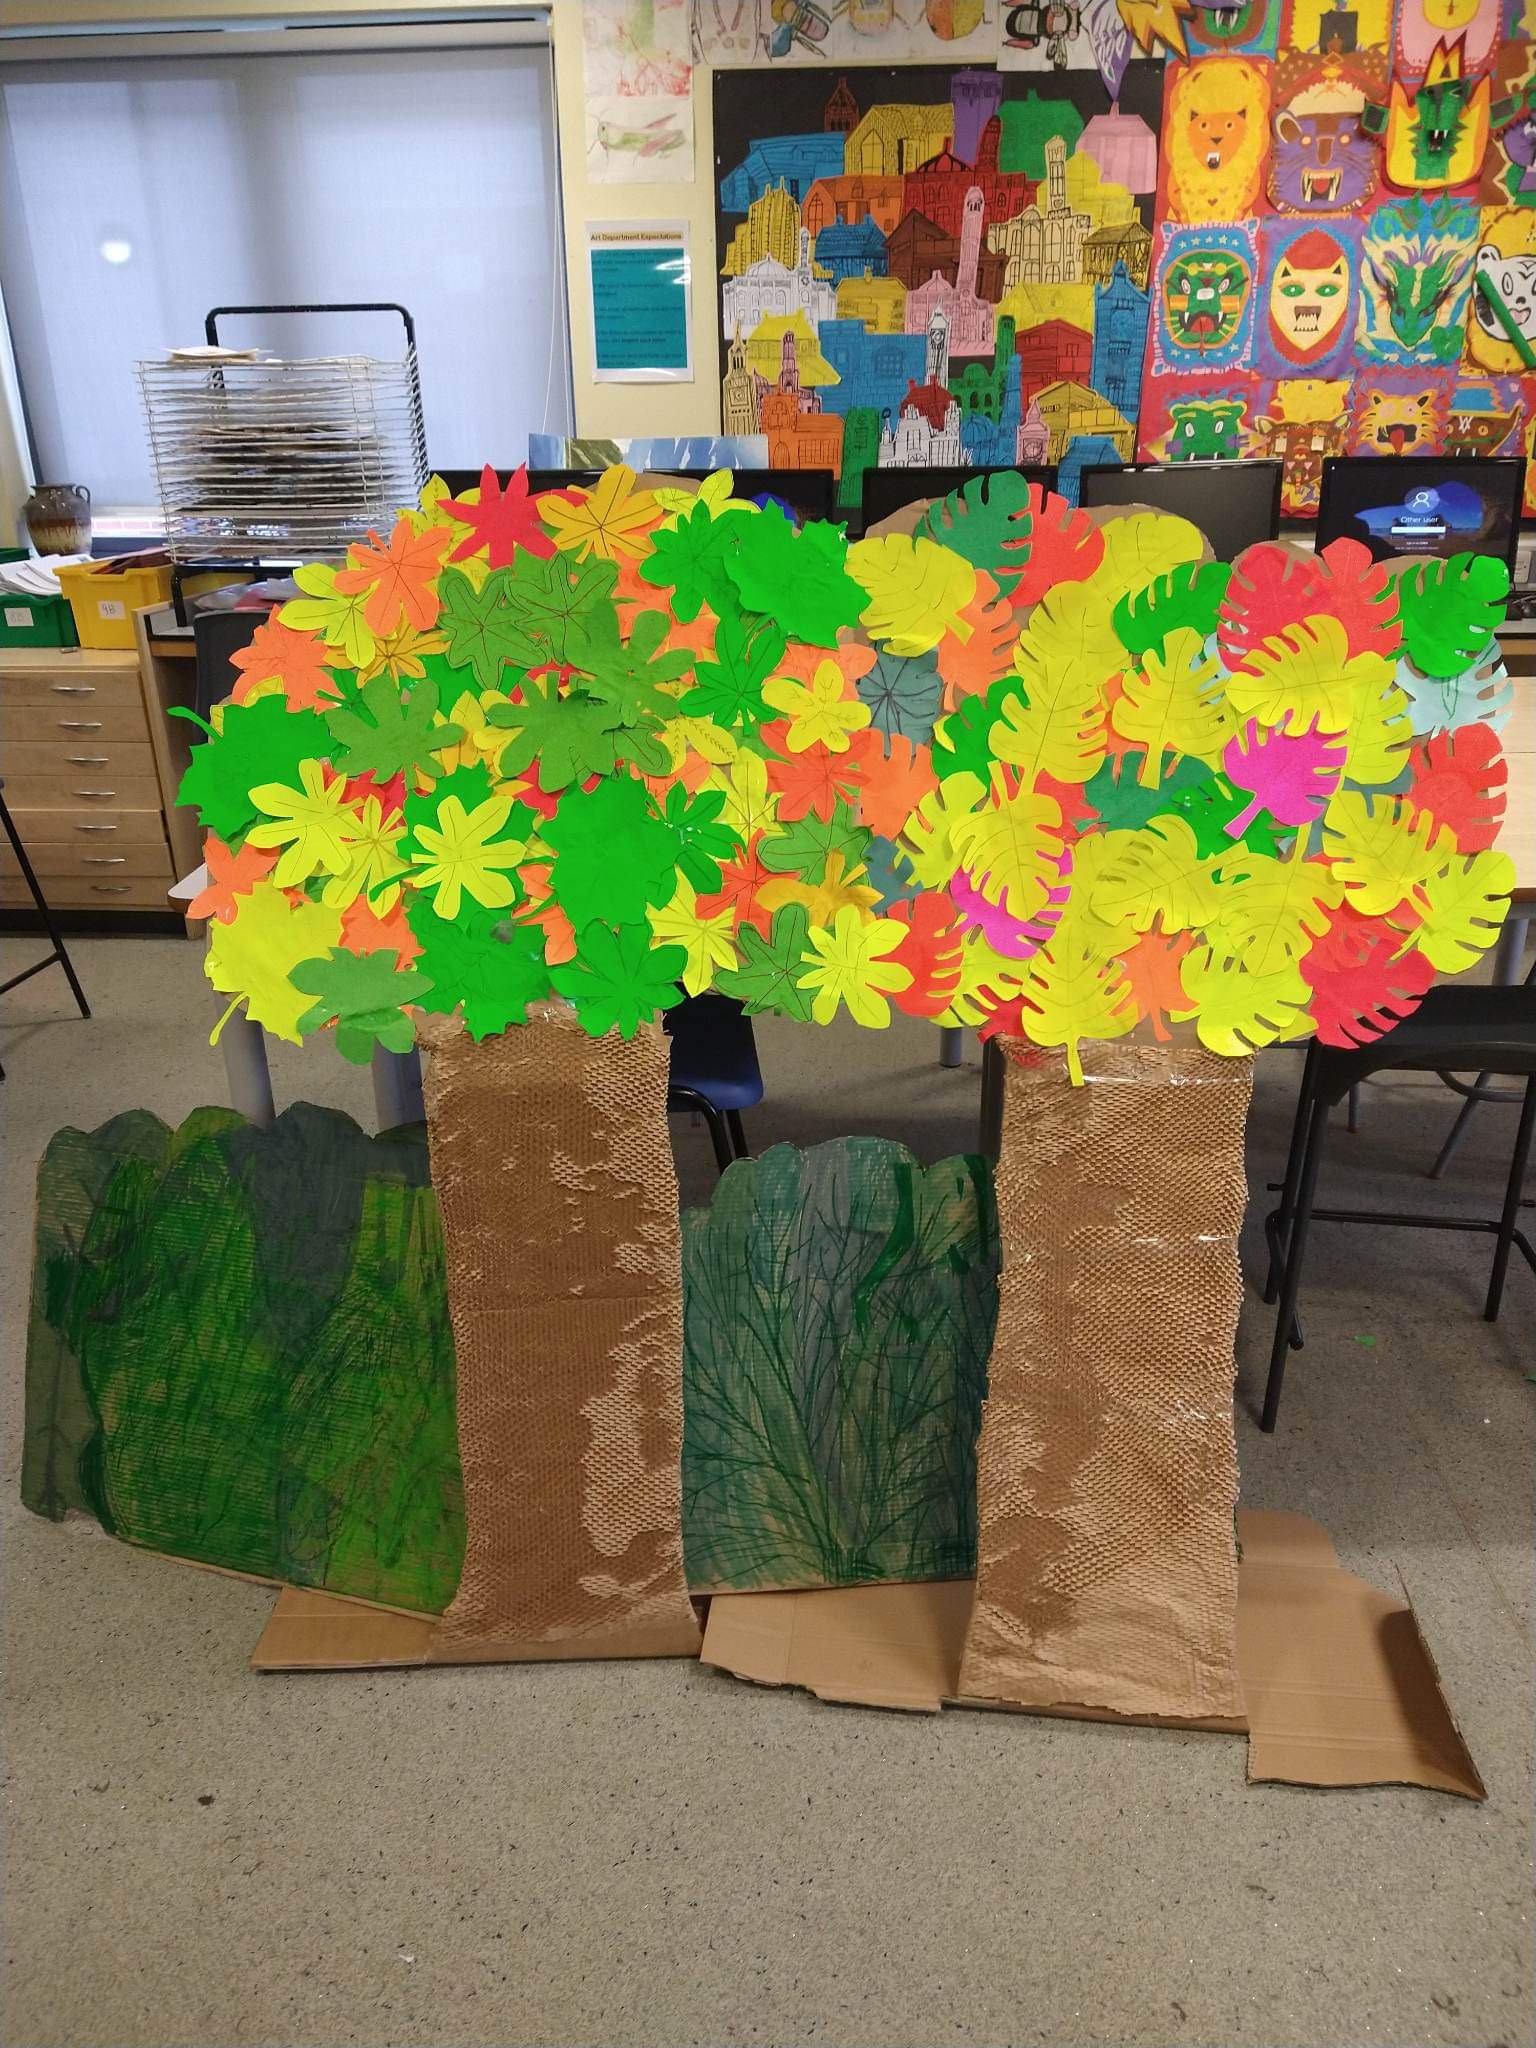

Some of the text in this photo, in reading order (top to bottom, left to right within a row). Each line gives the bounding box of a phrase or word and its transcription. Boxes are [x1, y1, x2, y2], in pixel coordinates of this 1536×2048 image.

[591, 232, 682, 242] Art Department Expectations
